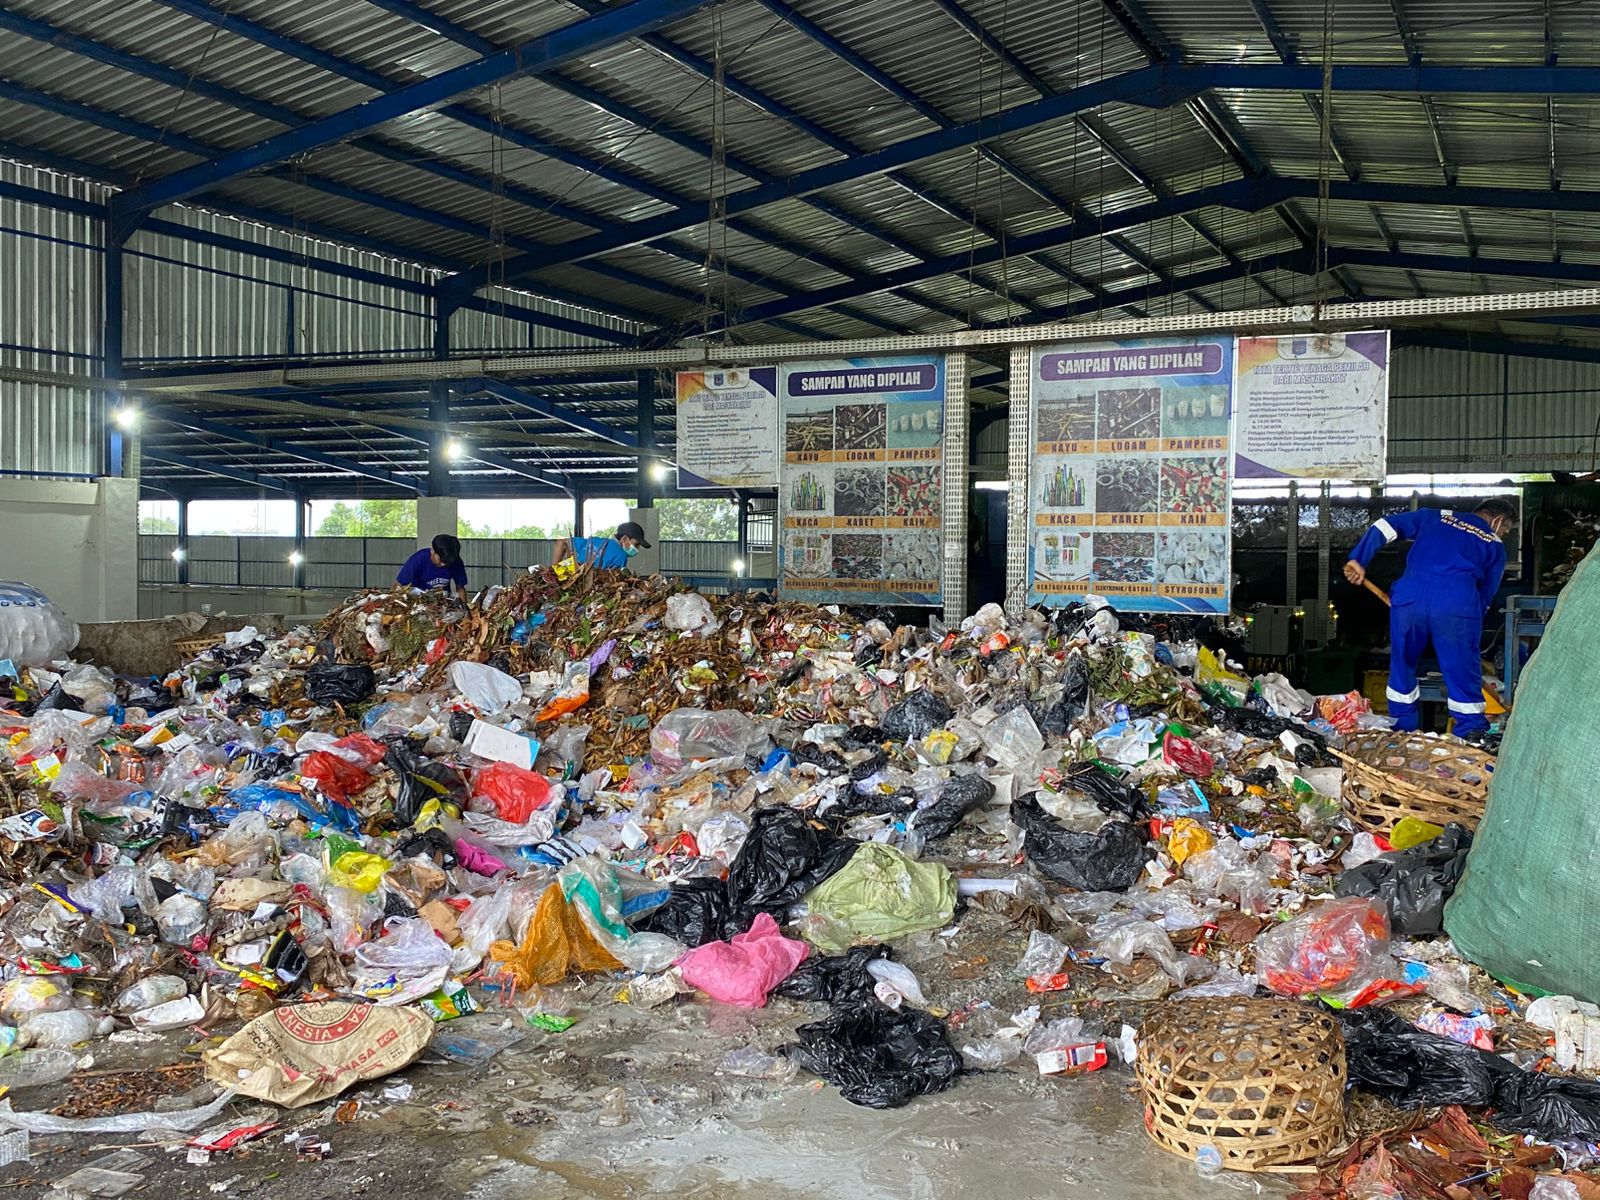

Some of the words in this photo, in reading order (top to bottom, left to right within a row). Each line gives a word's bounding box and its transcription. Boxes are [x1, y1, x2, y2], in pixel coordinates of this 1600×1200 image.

[1057, 358, 1110, 374] SAMPAH
[1114, 355, 1146, 371] YANG
[1150, 352, 1202, 370] DIPILAH
[1302, 364, 1333, 373] TENAGA
[1334, 362, 1369, 372] PEMILAH
[802, 372, 845, 391] SAMPAH
[847, 374, 875, 389] YANG
[877, 371, 920, 387] DIPILAH
[1273, 375, 1292, 385] DARI
[1294, 374, 1346, 384] MASYARAKAT
[1051, 443, 1077, 452] KAYU
[1111, 441, 1146, 450] LOGAM
[1170, 439, 1221, 449] PAMPERS
[797, 453, 819, 461] KAYU
[846, 452, 875, 460] LOGAM
[894, 450, 936, 459] PAMPERS
[796, 518, 818, 527] KACA
[846, 518, 873, 527] KARET
[903, 518, 925, 527] KAIN
[1050, 515, 1076, 523] KACA
[1111, 515, 1145, 524] KARET
[1181, 515, 1207, 524] KAIN
[1164, 586, 1218, 595] STYROFOAM
